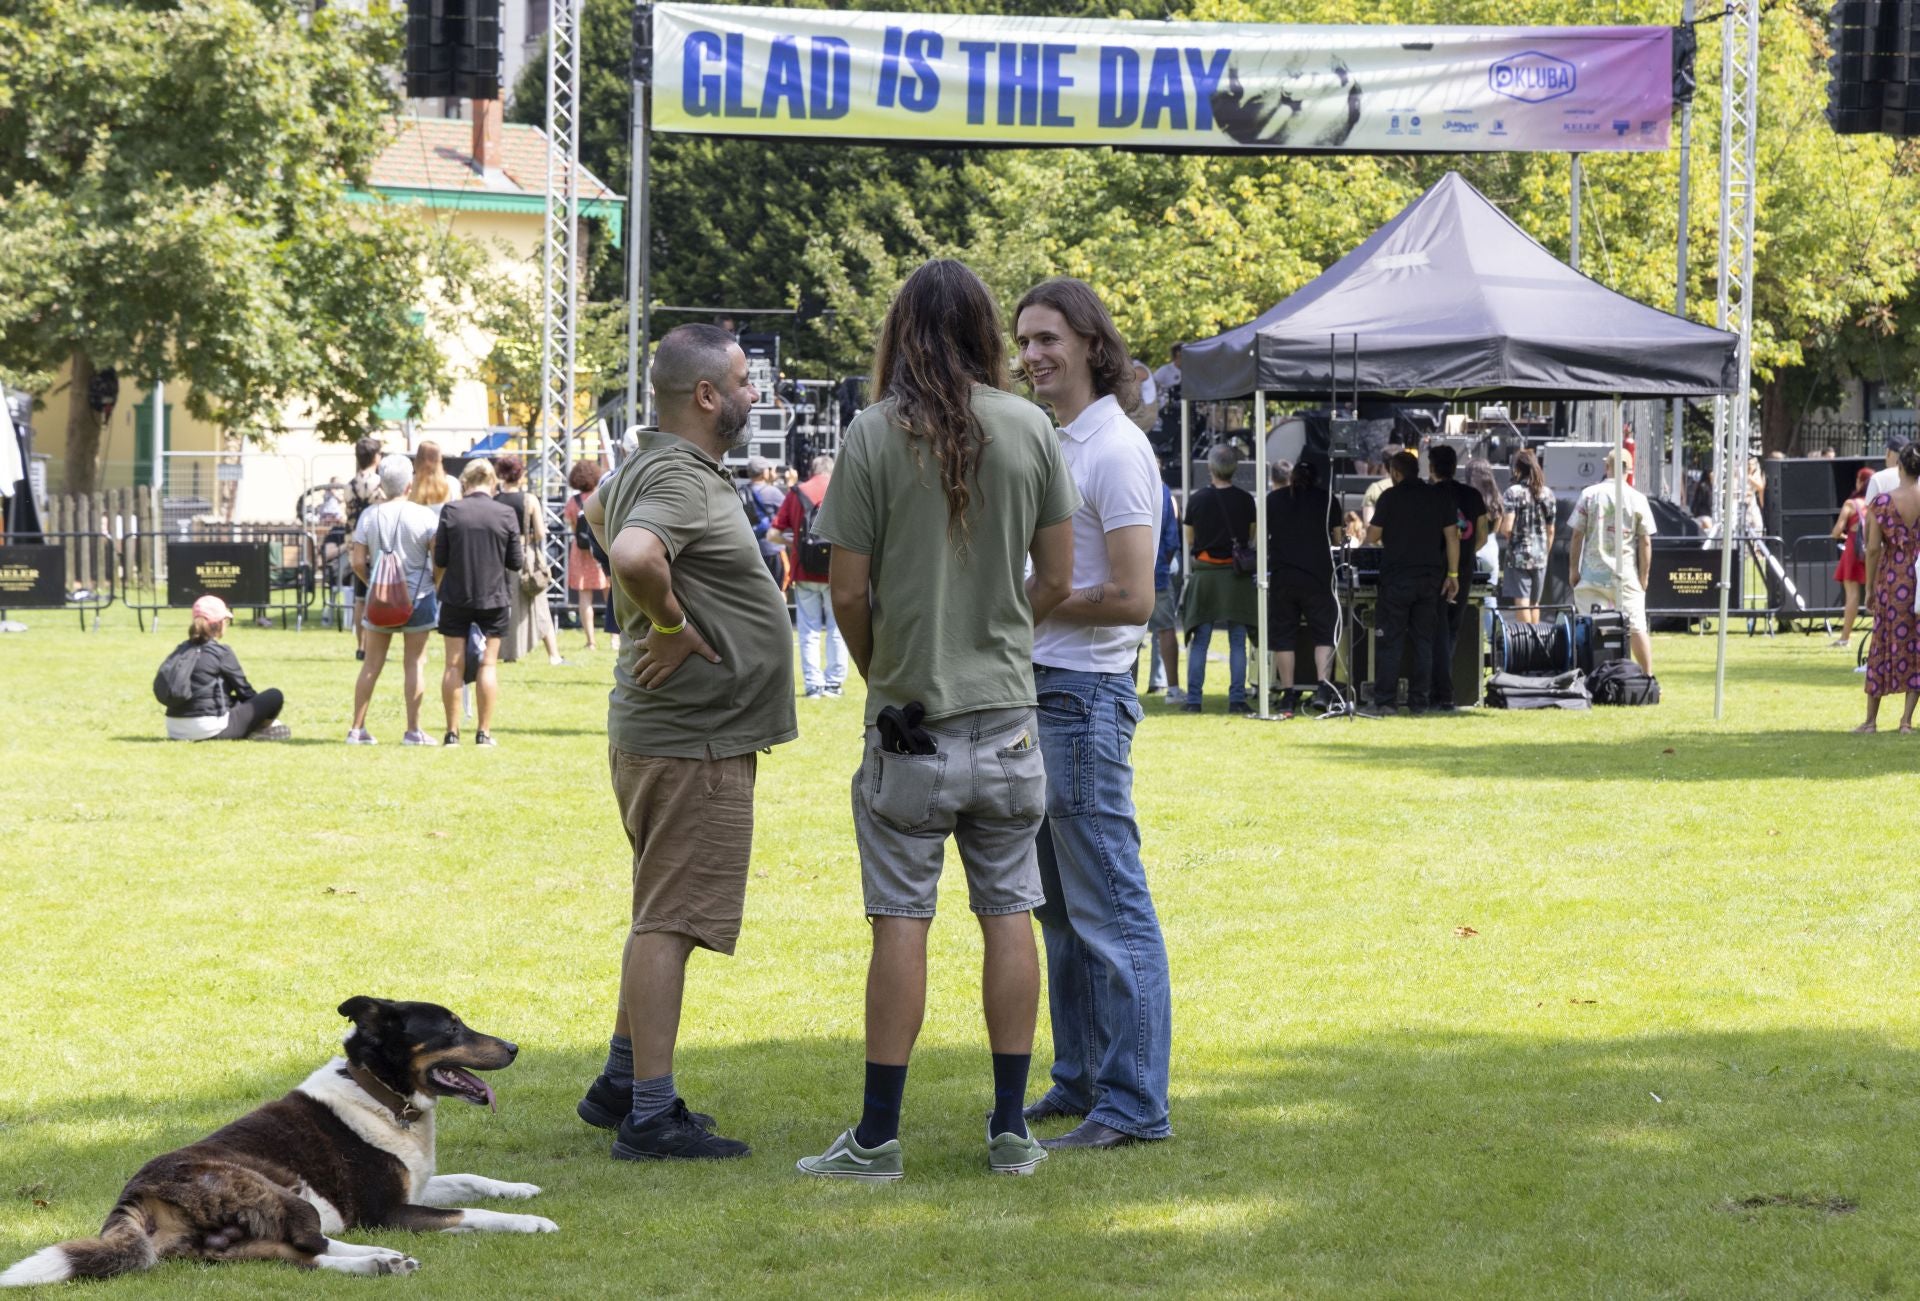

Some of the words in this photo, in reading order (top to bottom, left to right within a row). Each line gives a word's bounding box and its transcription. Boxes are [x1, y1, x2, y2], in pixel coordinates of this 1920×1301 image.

[682, 30, 850, 120] GLAD
[876, 25, 944, 113] IS
[959, 41, 1075, 128] THE
[1097, 45, 1232, 131] DAY
[196, 565, 241, 575] KELER
[1669, 572, 1712, 580] KELER
